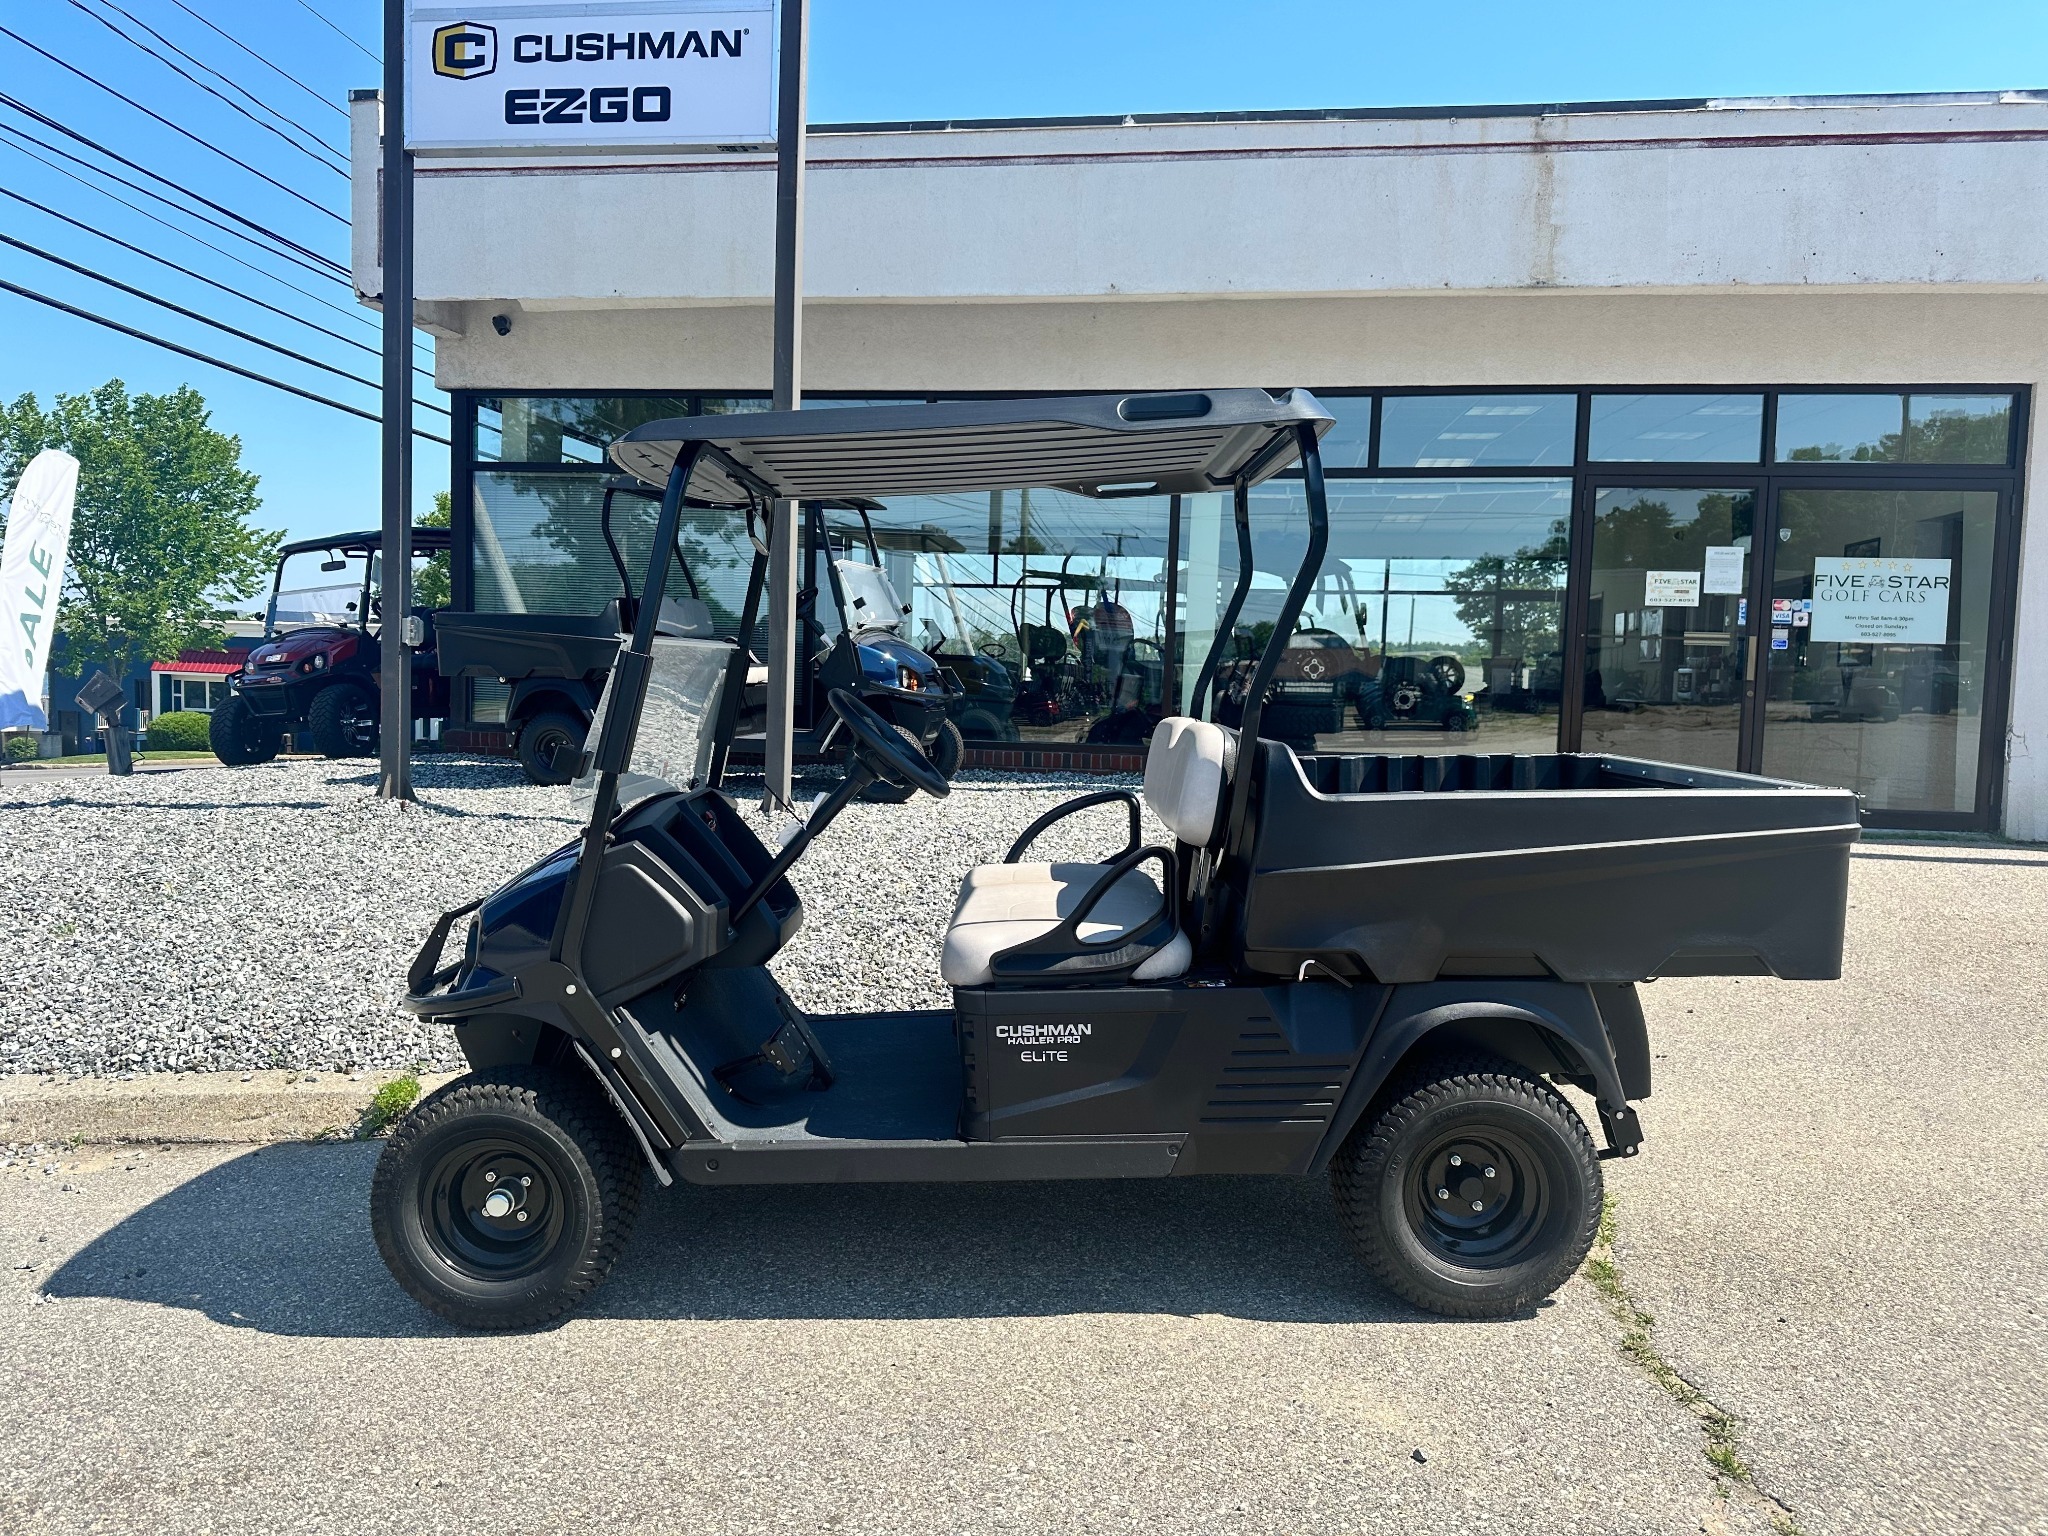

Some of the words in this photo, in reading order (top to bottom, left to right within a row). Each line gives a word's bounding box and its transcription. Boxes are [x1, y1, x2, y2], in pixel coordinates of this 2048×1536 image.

[1815, 574, 1865, 588] FIVE
[1887, 575, 1949, 589] STAR
[1821, 588, 1870, 602] GOLF
[1878, 590, 1926, 603] CARS
[996, 1023, 1092, 1038] CUSHMAN
[1007, 1036, 1055, 1045] HAULER
[1057, 1035, 1081, 1044] PRO
